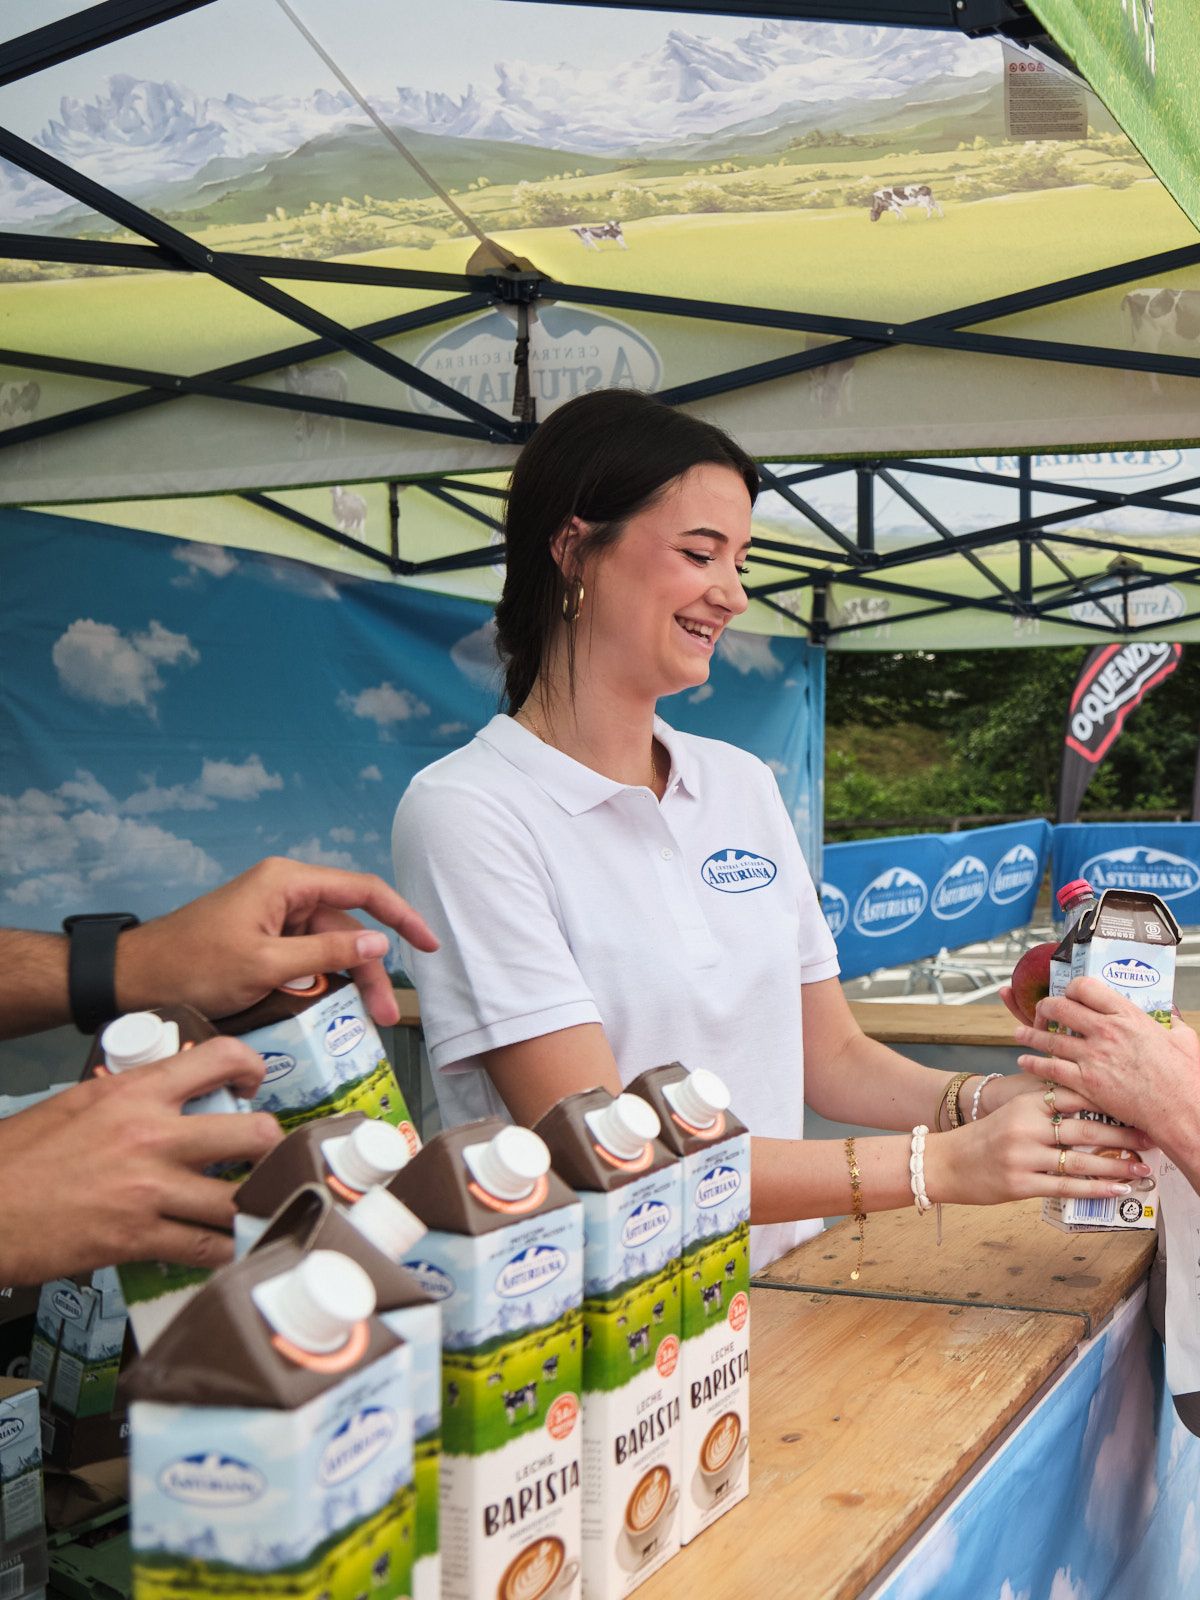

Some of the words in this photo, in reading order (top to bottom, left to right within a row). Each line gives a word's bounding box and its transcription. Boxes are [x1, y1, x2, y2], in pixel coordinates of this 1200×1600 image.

[707, 867, 772, 885] ASTURIANA
[1090, 865, 1194, 889] ASTURIANA
[1106, 966, 1156, 983] ASTURIANA
[698, 1179, 738, 1201] ASTURIANA
[625, 1214, 667, 1240] ASTURIANA
[711, 1341, 735, 1364] LECHE
[690, 1349, 750, 1409] BARISTA
[636, 1389, 663, 1415] LECHE
[614, 1396, 680, 1465] BARISTA
[515, 1452, 554, 1482] LECHE
[484, 1459, 579, 1538] BARISTA
